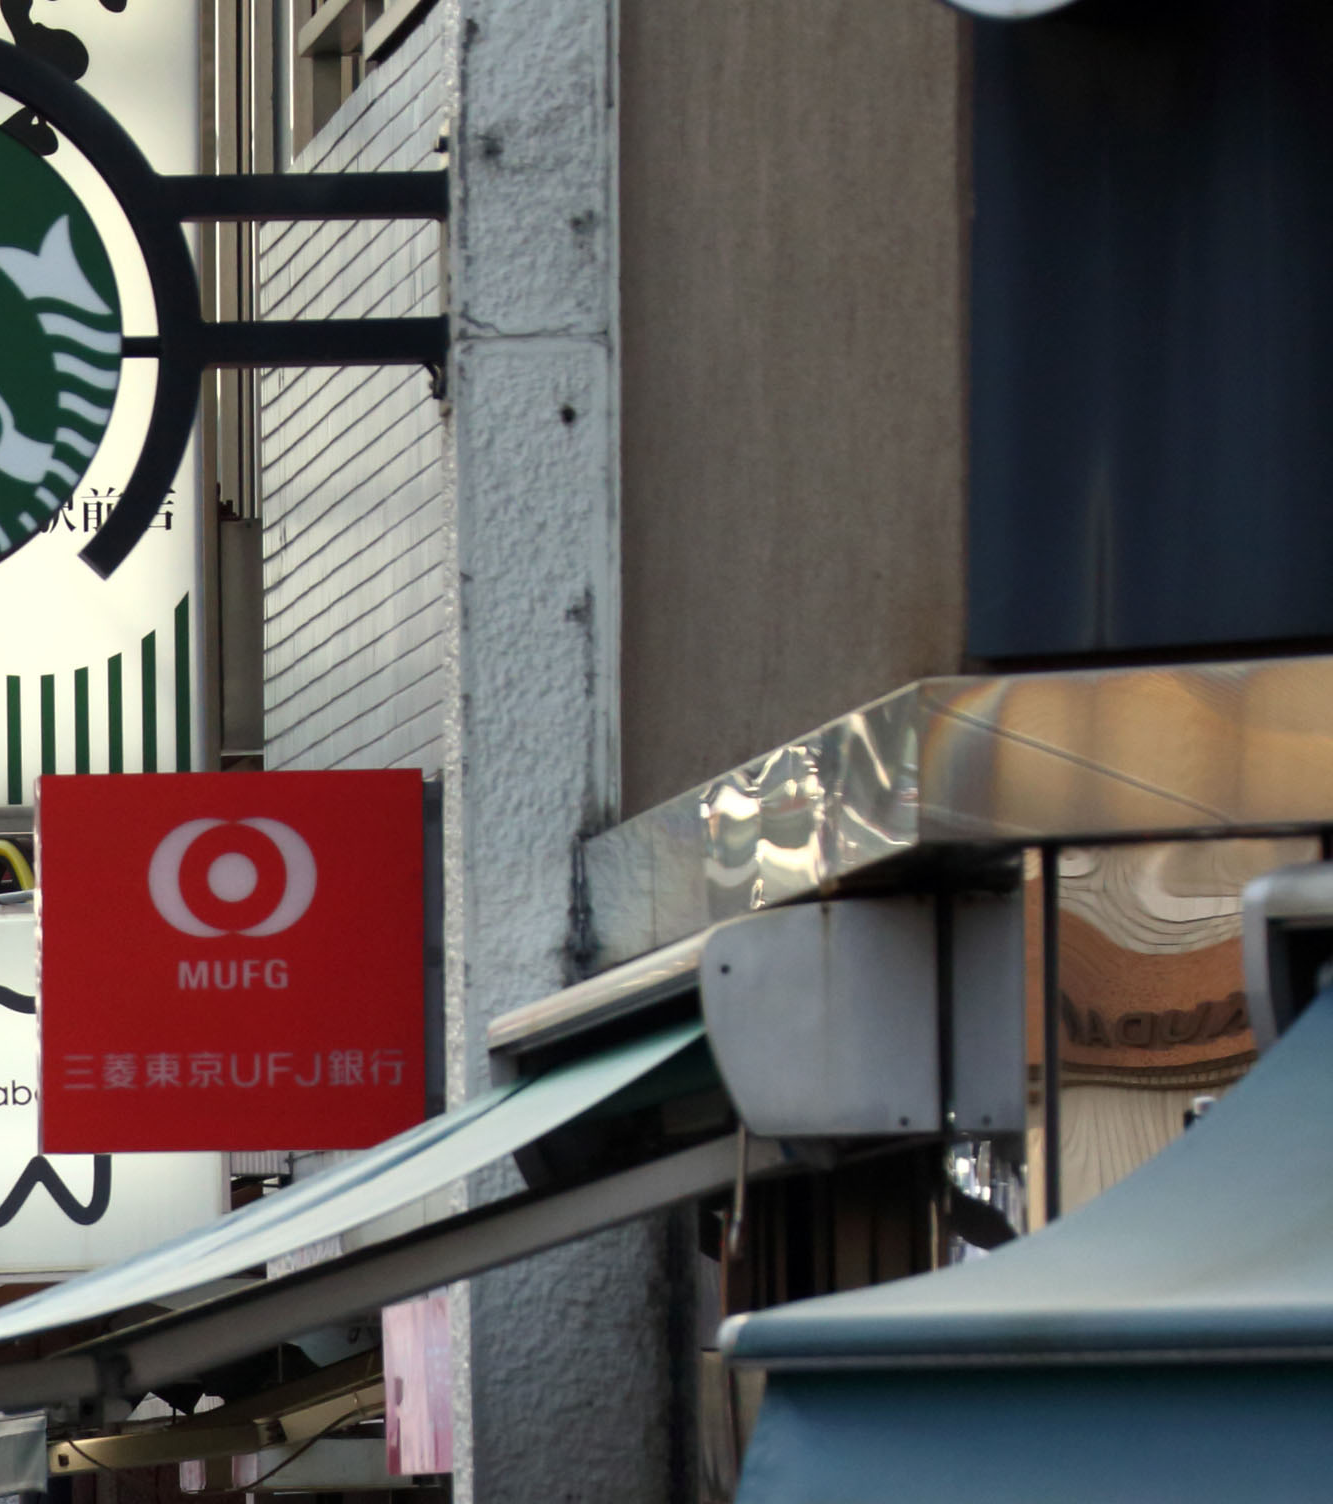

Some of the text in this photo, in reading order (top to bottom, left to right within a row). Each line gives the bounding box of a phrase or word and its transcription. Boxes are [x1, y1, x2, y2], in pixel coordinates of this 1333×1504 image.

[178, 958, 290, 990] MUFG
[62, 1049, 407, 1091] 三菱東京UFJ銀行
